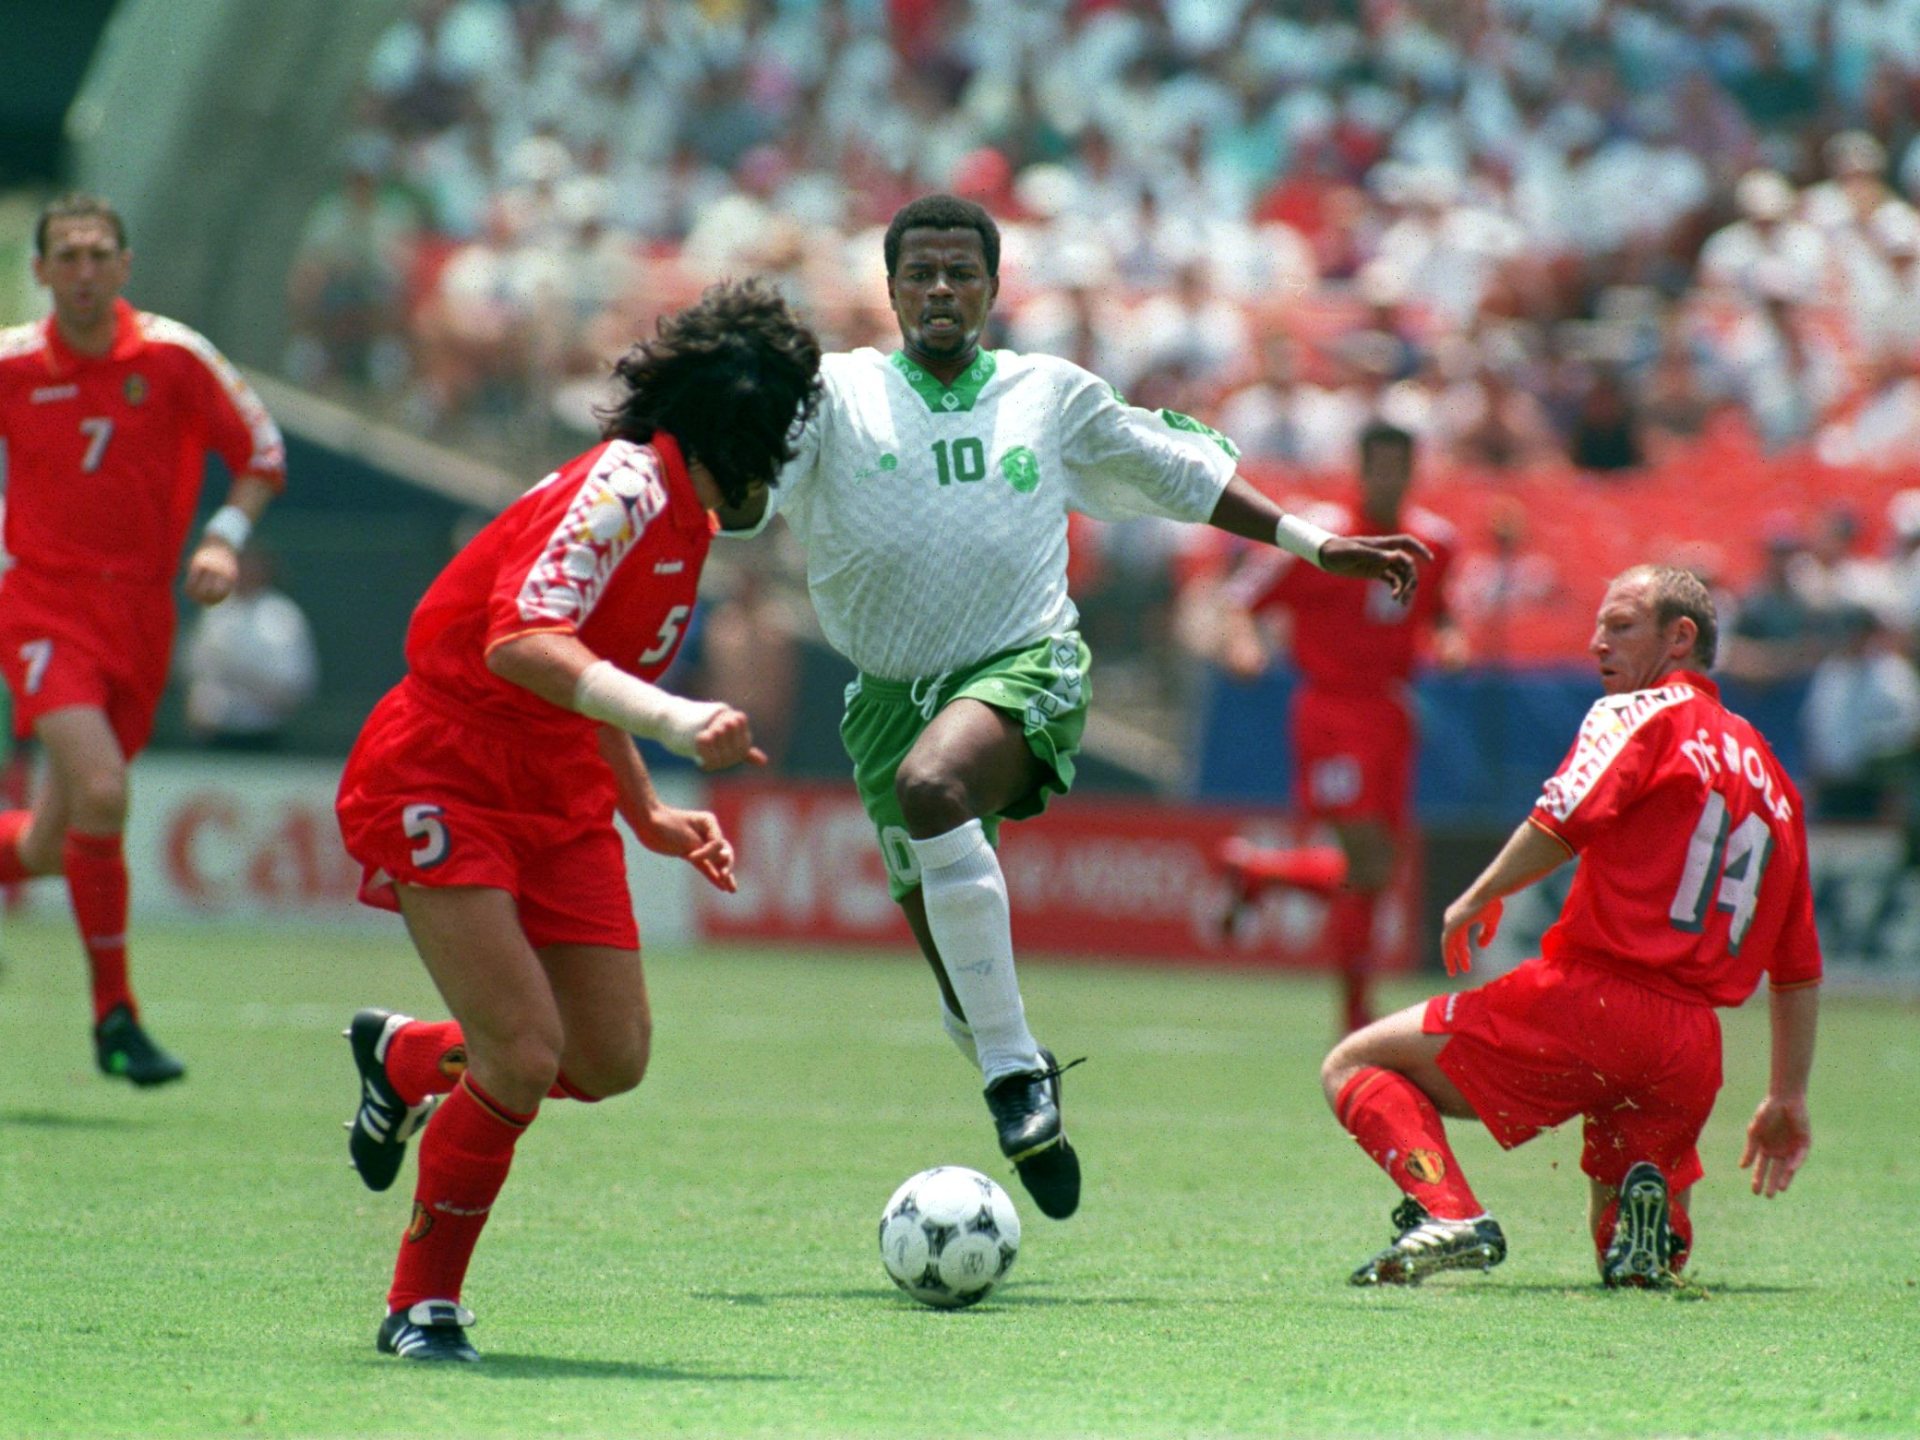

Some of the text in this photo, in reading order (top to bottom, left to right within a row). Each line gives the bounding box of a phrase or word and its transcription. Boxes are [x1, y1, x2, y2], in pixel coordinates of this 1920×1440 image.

[80, 416, 116, 475] 7
[931, 437, 986, 486] 10
[638, 604, 691, 667] 5
[19, 638, 54, 695] 7
[402, 803, 451, 869] 5
[1669, 786, 1774, 956] 14
